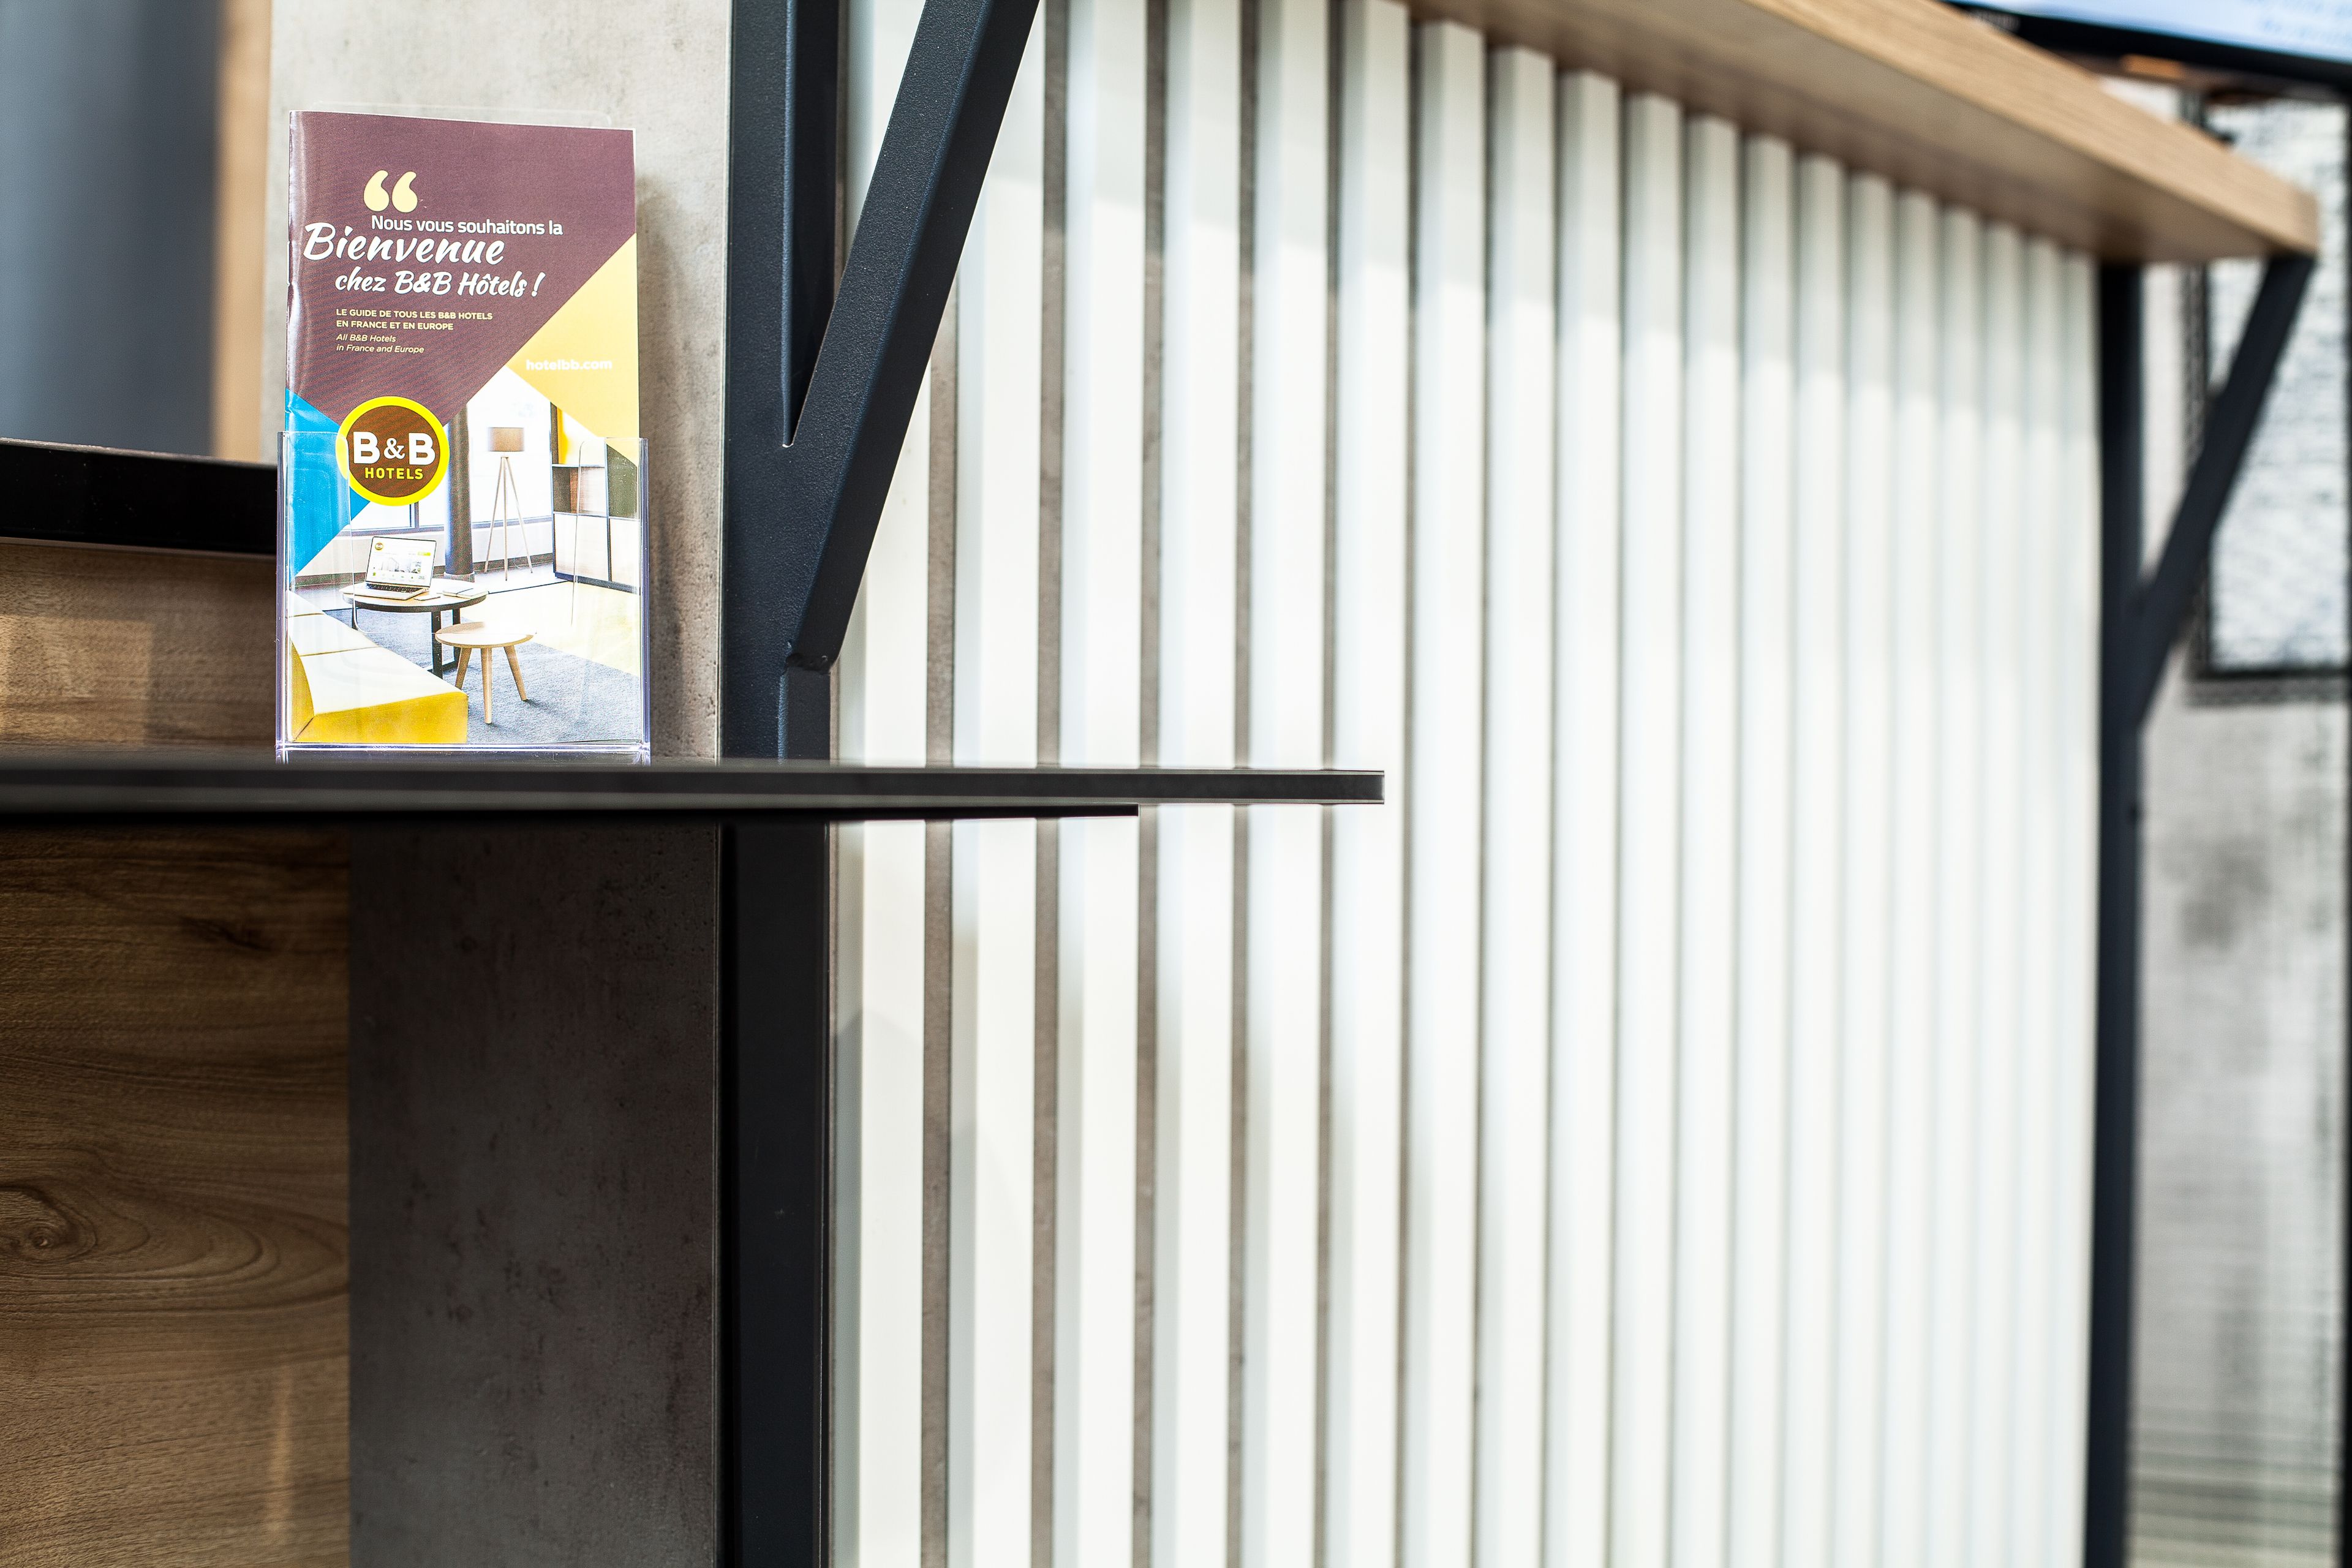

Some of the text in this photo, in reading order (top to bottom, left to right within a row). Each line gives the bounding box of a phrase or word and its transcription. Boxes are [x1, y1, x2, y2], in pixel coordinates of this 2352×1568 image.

[371, 215, 564, 235] Nous vous souhaitons la
[303, 222, 505, 265] Bienvenue
[335, 266, 387, 293] chez
[394, 271, 452, 295] B&B
[349, 309, 378, 317] GUIDE
[458, 312, 493, 320] HOTELS
[351, 320, 388, 329] FRANCE
[394, 345, 424, 355] Europe
[526, 359, 612, 371] hotelbb.com
[364, 467, 424, 480] HOTELS
